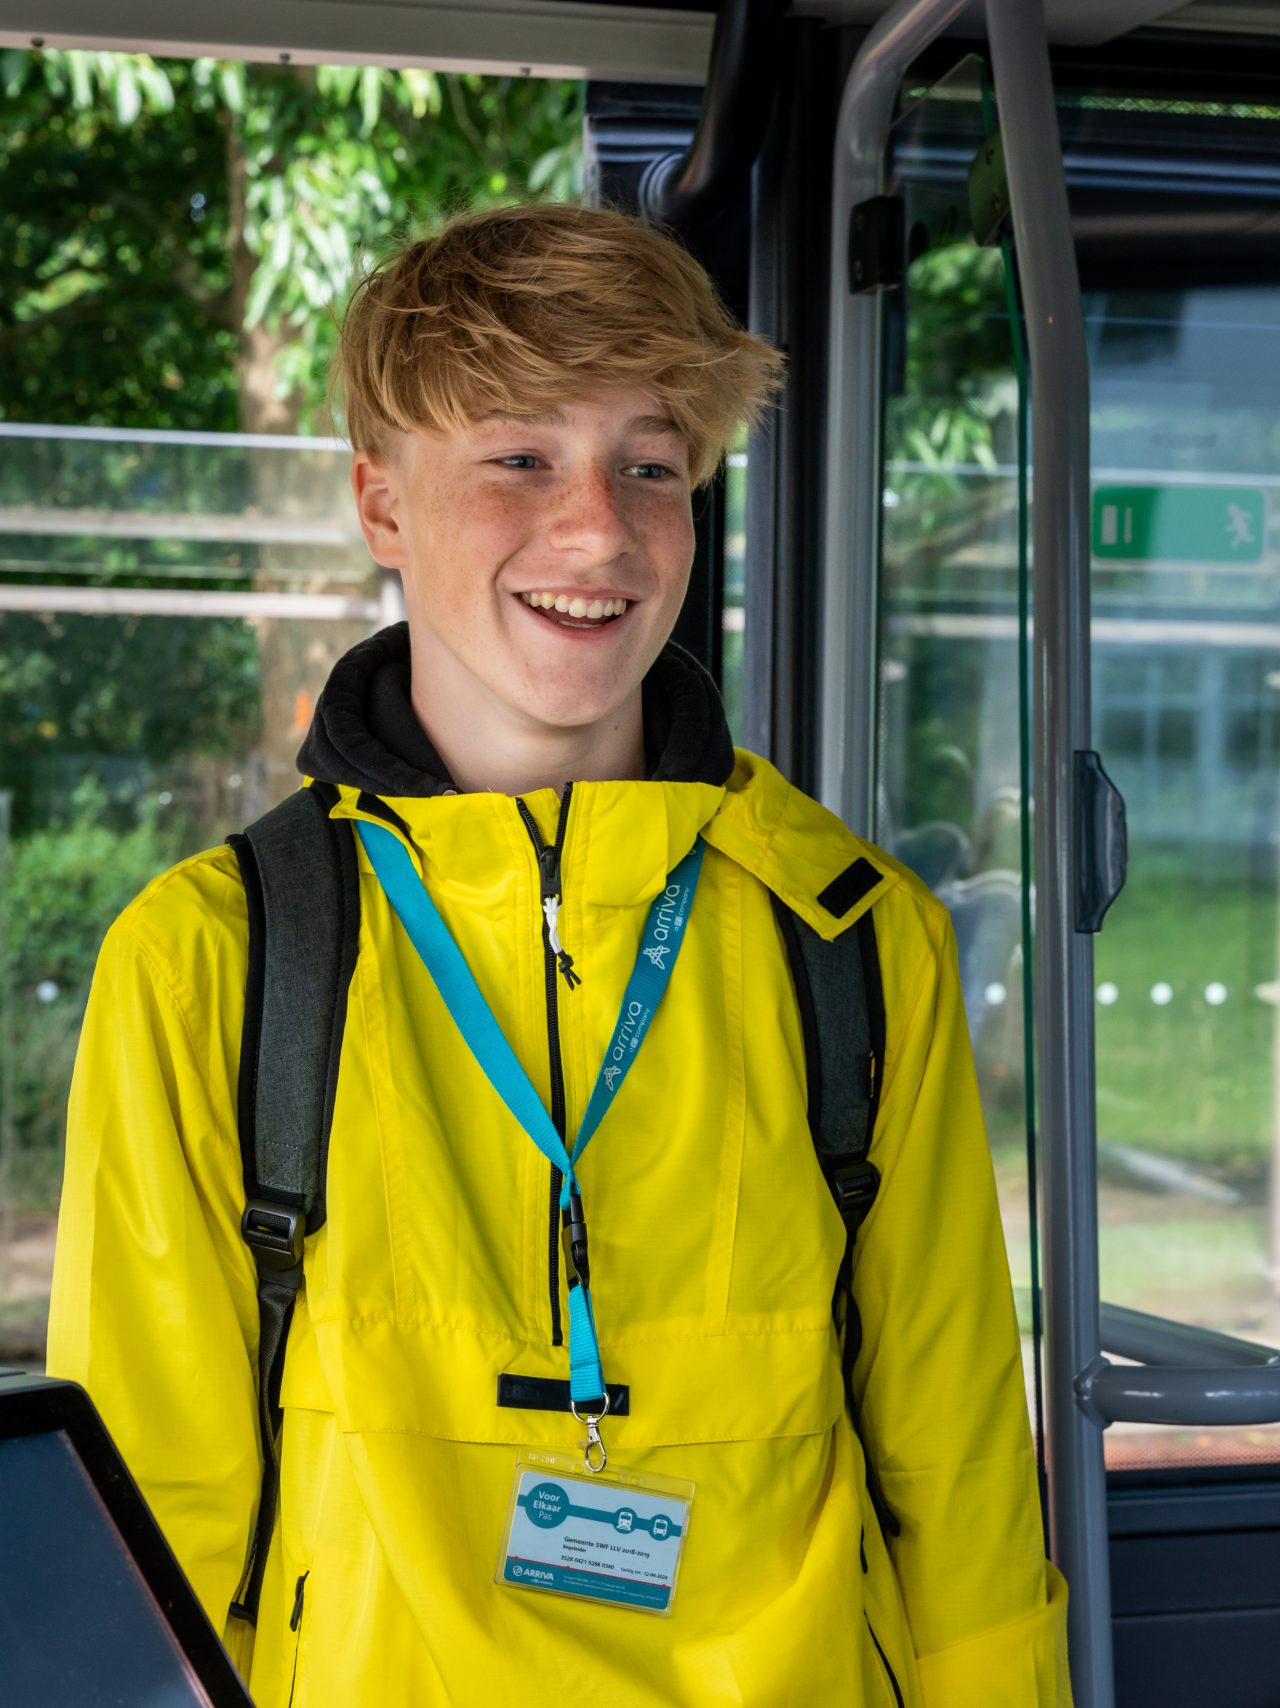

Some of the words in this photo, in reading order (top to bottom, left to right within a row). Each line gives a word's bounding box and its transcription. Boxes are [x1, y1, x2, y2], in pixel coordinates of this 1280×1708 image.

[679, 887, 691, 916] company
[654, 884, 681, 941] arriva
[635, 1008, 651, 1038] company
[612, 1001, 643, 1061] arriva
[538, 1490, 561, 1502] Voor
[533, 1500, 562, 1513] Elkaar
[538, 1511, 552, 1521] Pas
[564, 1536, 595, 1548] Gemeente
[596, 1542, 609, 1550] SWF
[523, 1568, 554, 1581] ARRIVA
